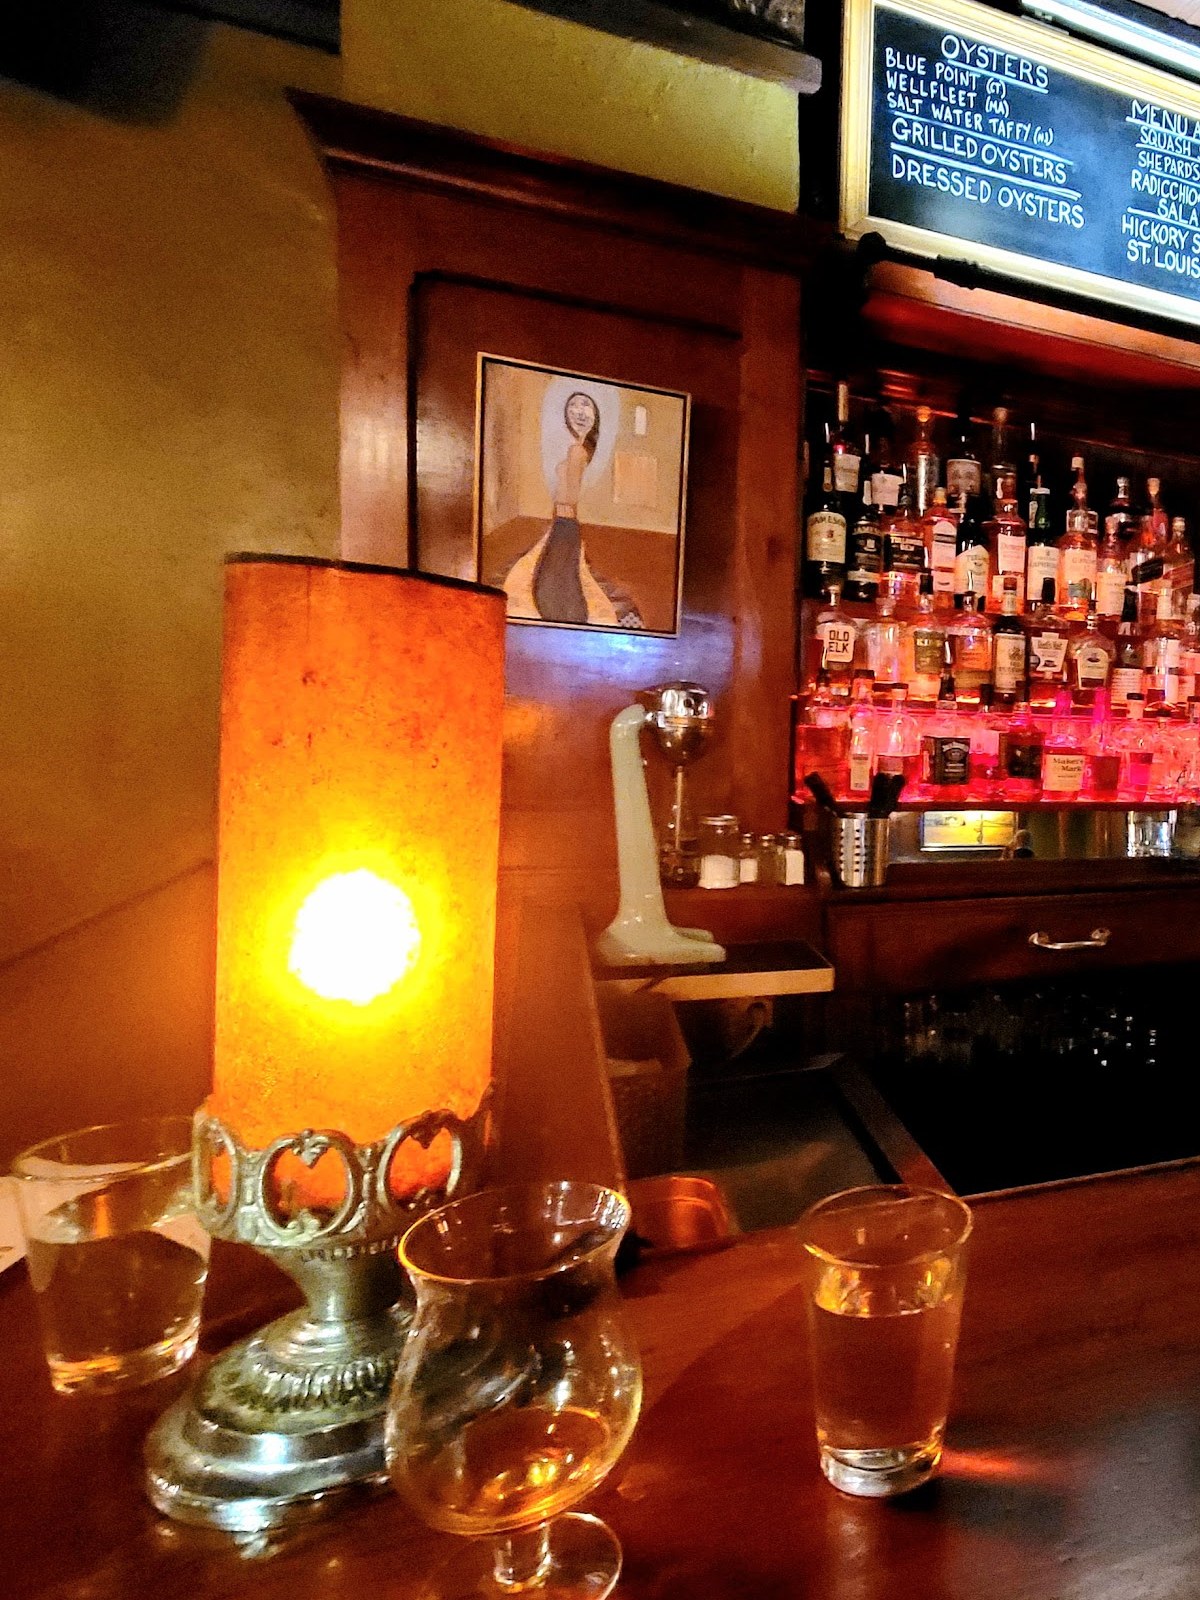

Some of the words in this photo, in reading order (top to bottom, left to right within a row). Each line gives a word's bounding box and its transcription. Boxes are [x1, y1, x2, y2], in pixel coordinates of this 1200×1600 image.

[885, 47, 926, 75] BLUE
[936, 63, 980, 90] POINT
[941, 35, 1049, 88] OYSTERS
[886, 71, 977, 108] WELLFLEET
[986, 97, 1009, 118] (MA)
[887, 92, 922, 115] SALT
[932, 105, 982, 131] WATER
[989, 118, 1030, 142] TAFFY
[1132, 100, 1188, 135] MENU
[892, 118, 977, 158] GRILLED
[982, 143, 1066, 184] OYSTERS
[1140, 127, 1191, 156] SQUASH
[1138, 151, 1200, 181] SHEPARD'S
[893, 154, 991, 203] DRESSED
[997, 187, 1085, 228] OYSTERS
[1122, 215, 1190, 250] HICKORY
[1127, 239, 1152, 264] ST.
[1155, 246, 1200, 279] LOUIS
[829, 630, 849, 641] OLD
[829, 641, 849, 653] ELK
